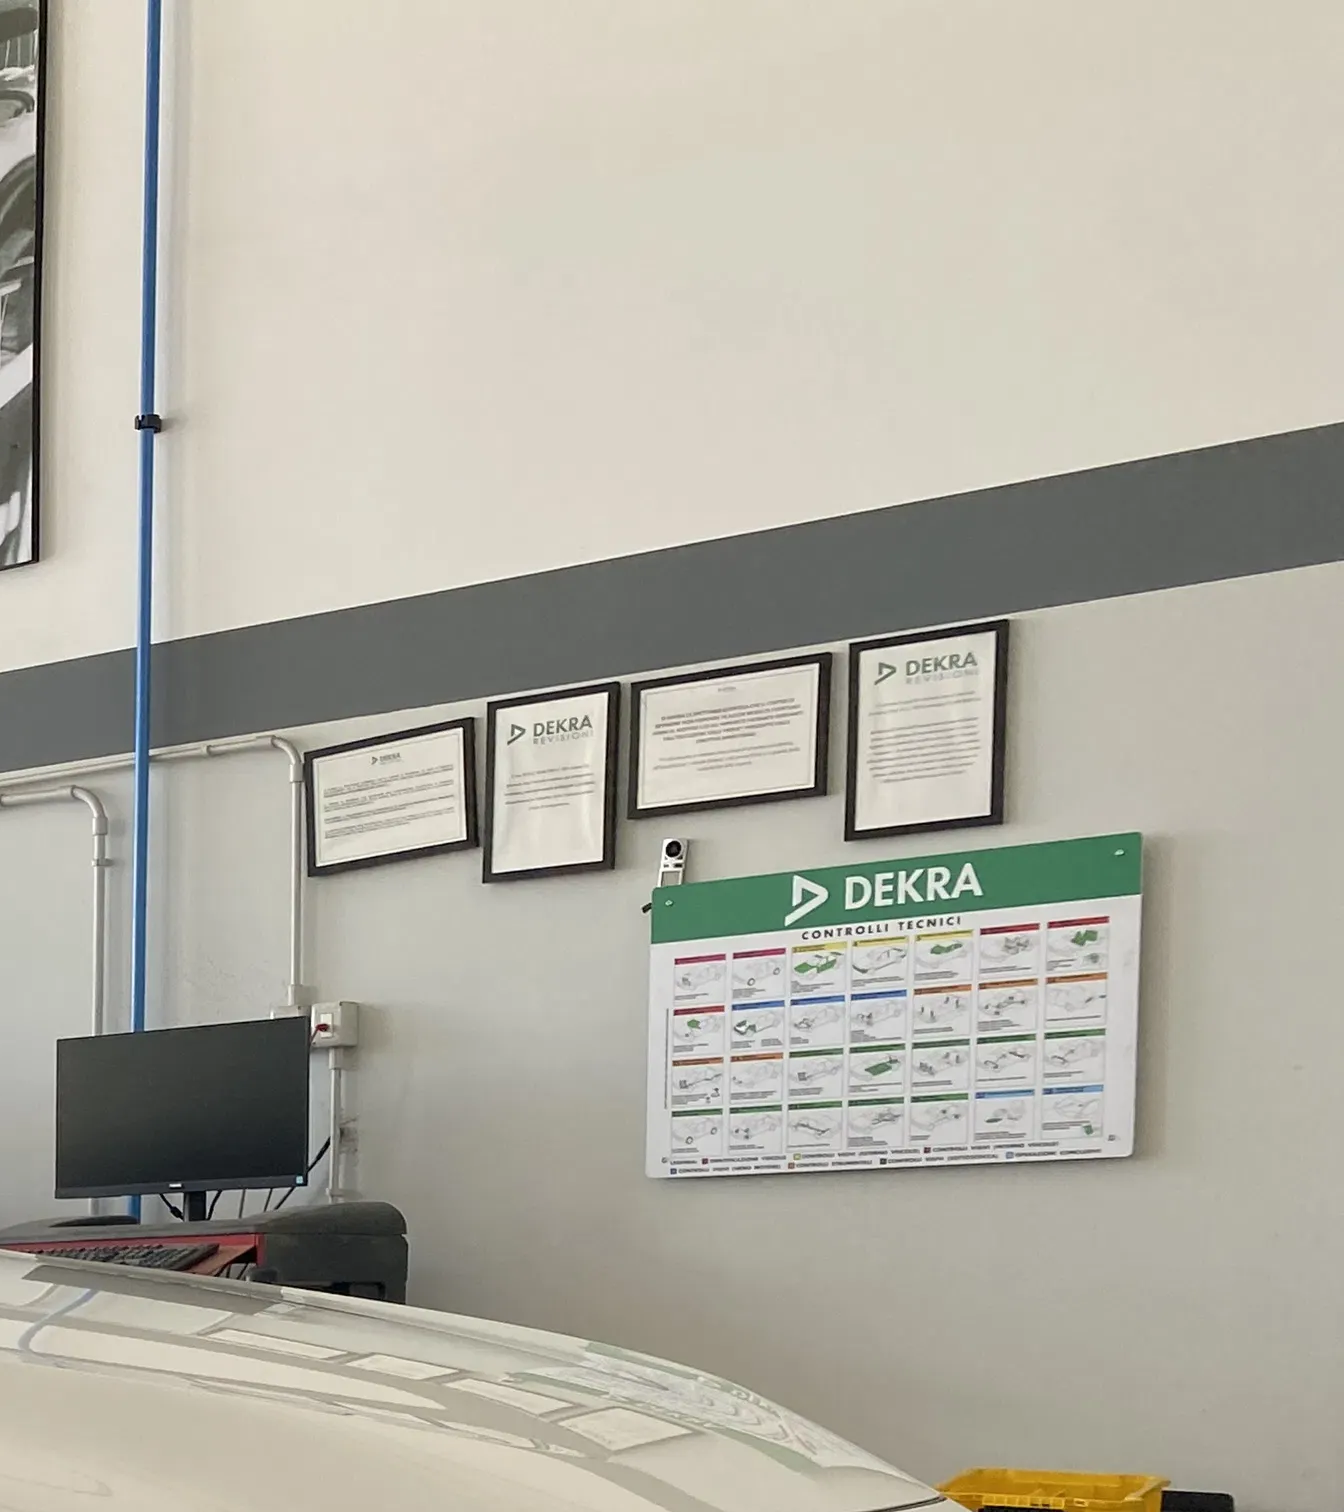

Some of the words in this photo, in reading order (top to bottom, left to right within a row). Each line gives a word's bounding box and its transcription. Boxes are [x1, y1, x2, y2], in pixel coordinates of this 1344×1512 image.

[905, 652, 978, 676] DEKRA
[533, 714, 593, 737] DEKRA
[844, 862, 984, 910] DEKRA
[801, 924, 889, 941] CONTROLLI
[899, 916, 961, 931] TECNICI
